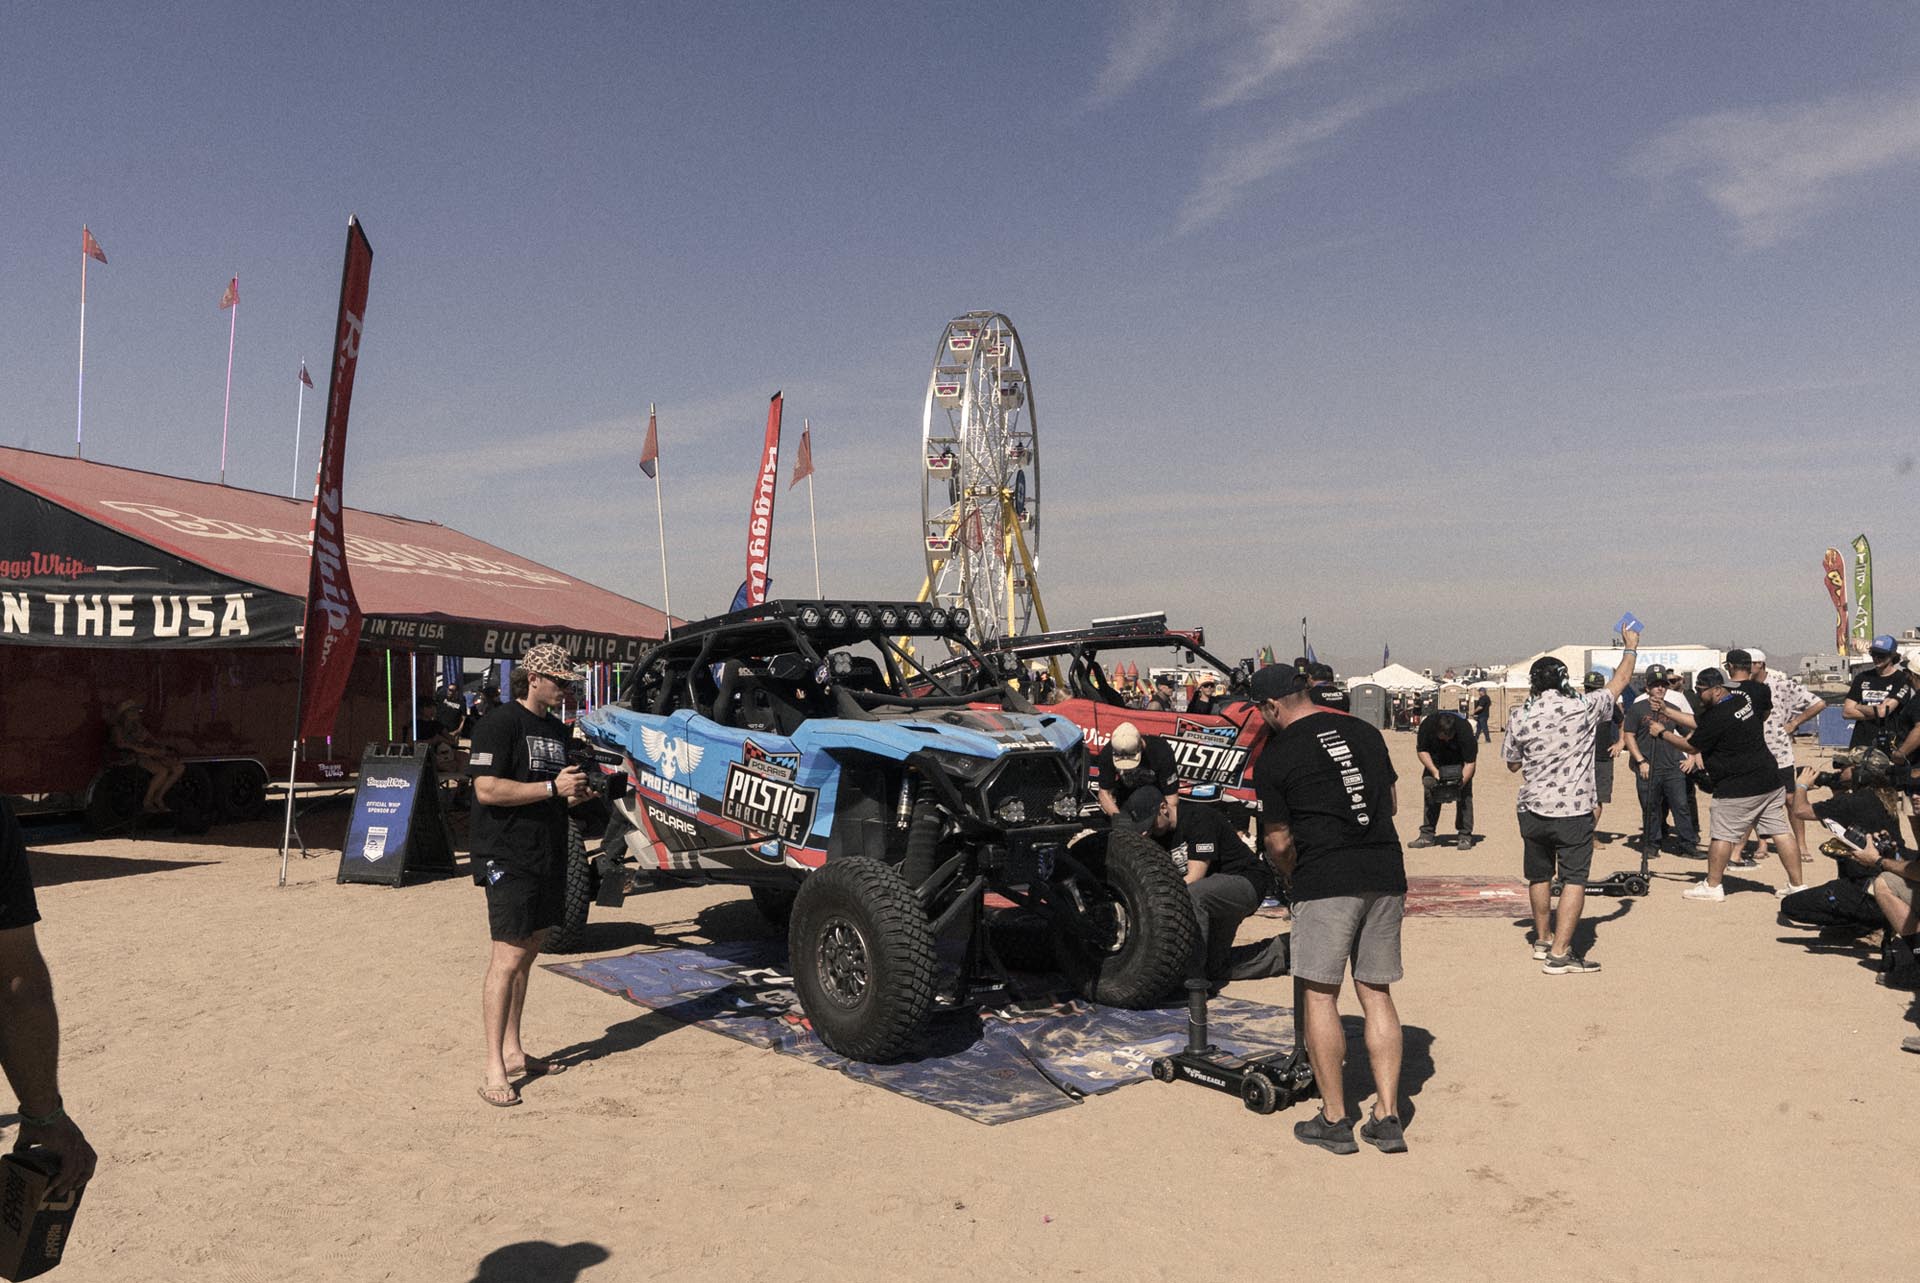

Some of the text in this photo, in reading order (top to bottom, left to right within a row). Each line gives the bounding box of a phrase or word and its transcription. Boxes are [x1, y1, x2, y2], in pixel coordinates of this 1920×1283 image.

[1, 592, 250, 637] N THE USA
[370, 619, 387, 635] IN
[390, 620, 417, 637] THE
[419, 623, 446, 639] USA
[484, 629, 666, 662] BUGGYWHIP.CO
[1637, 652, 1679, 664] ATER
[1186, 732, 1225, 743] POLARIS
[751, 762, 787, 777] POLARIS
[640, 770, 662, 794] PRO
[661, 779, 698, 806] EAGLE
[648, 806, 697, 836] POLARIS
[726, 801, 801, 840] CHALLEGE
[1206, 1076, 1226, 1086] EAGLE
